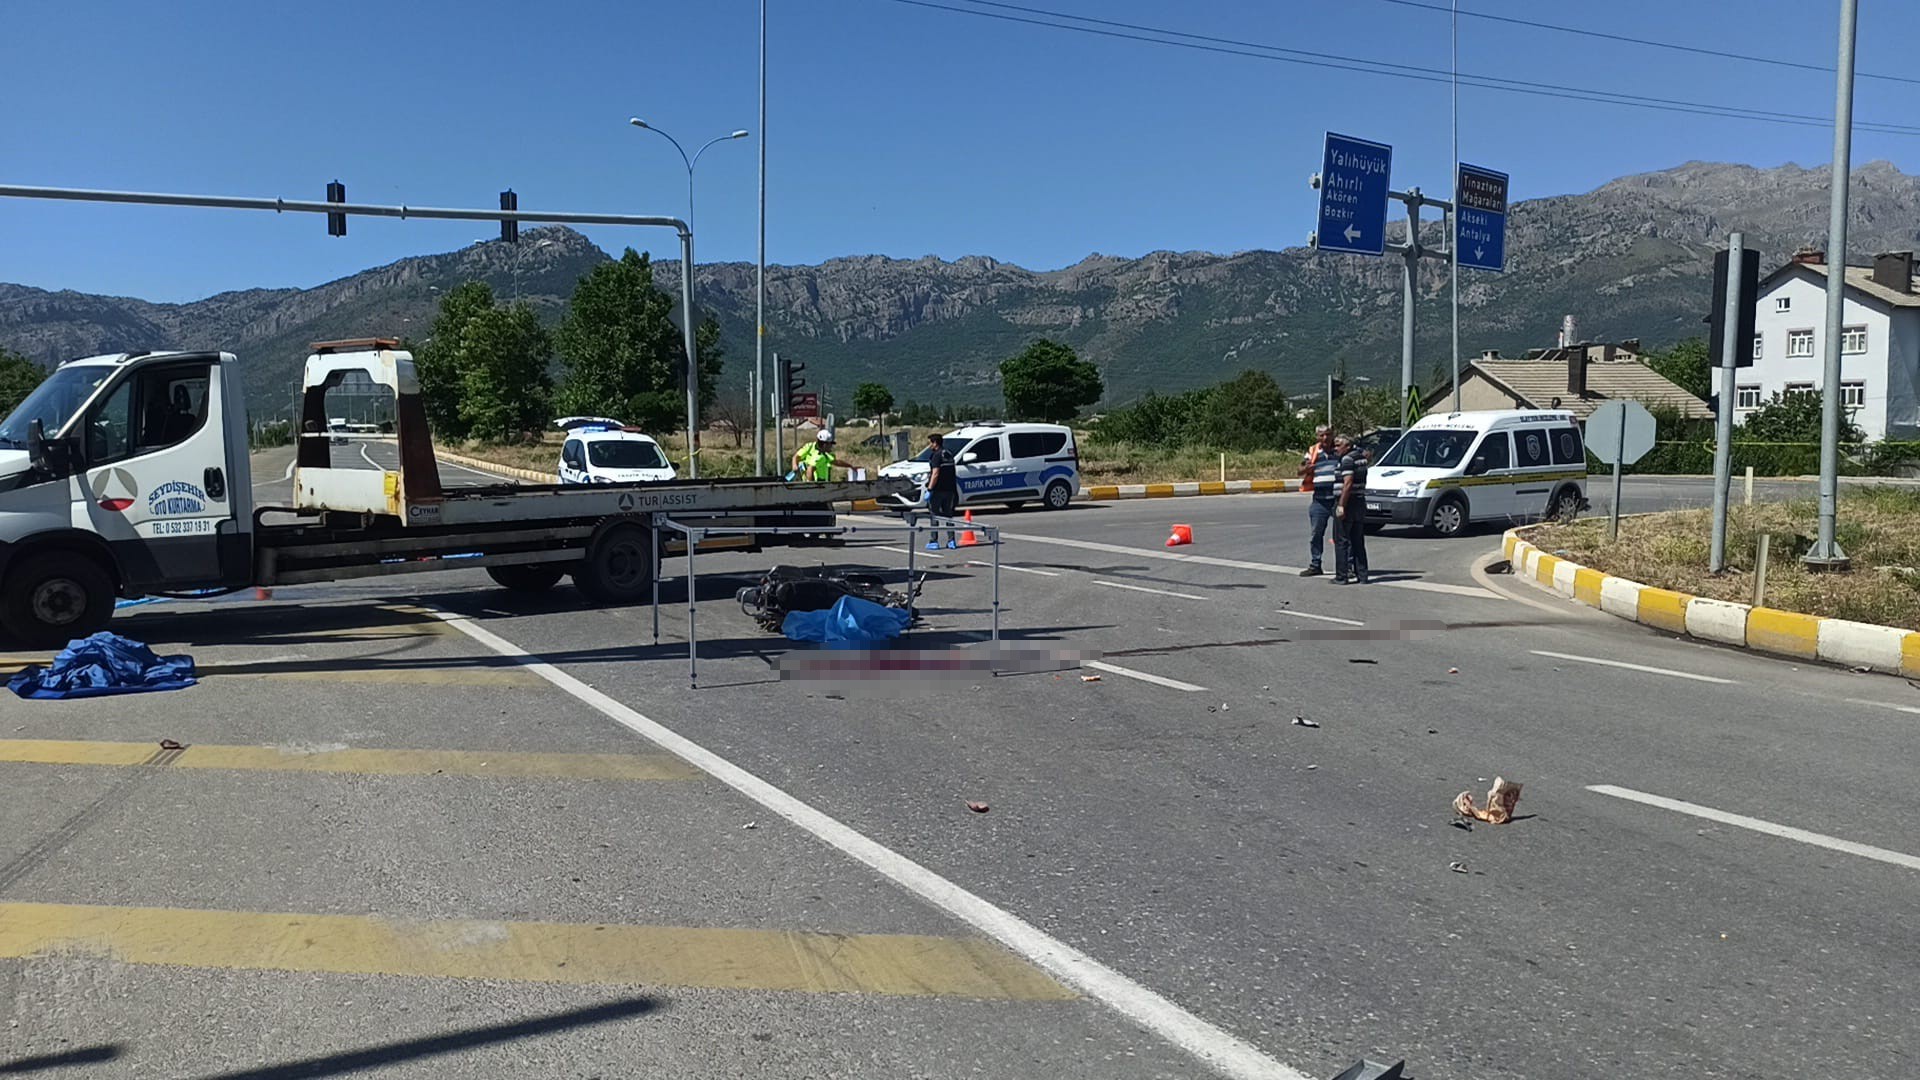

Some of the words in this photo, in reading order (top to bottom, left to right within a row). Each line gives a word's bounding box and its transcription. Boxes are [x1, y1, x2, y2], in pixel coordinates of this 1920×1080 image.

[1330, 149, 1386, 175] Yalıhüyük
[1327, 172, 1363, 192] Ahırlı
[1463, 175, 1502, 196] Tınaztepe
[1326, 189, 1358, 204] Akören
[1462, 191, 1502, 209] Mağaraları
[1324, 205, 1354, 219] Bozkır
[1461, 211, 1488, 225] Akseki
[1459, 226, 1491, 244] Antalya
[148, 480, 206, 506] SEYDİŞEHİR
[639, 495, 659, 506] TUR
[662, 494, 697, 505] ASSIST
[154, 500, 167, 515] OTO
[167, 497, 202, 514] KURTARMA
[165, 522, 170, 534] 0
[170, 522, 182, 534] 532
[182, 521, 193, 533] 337
